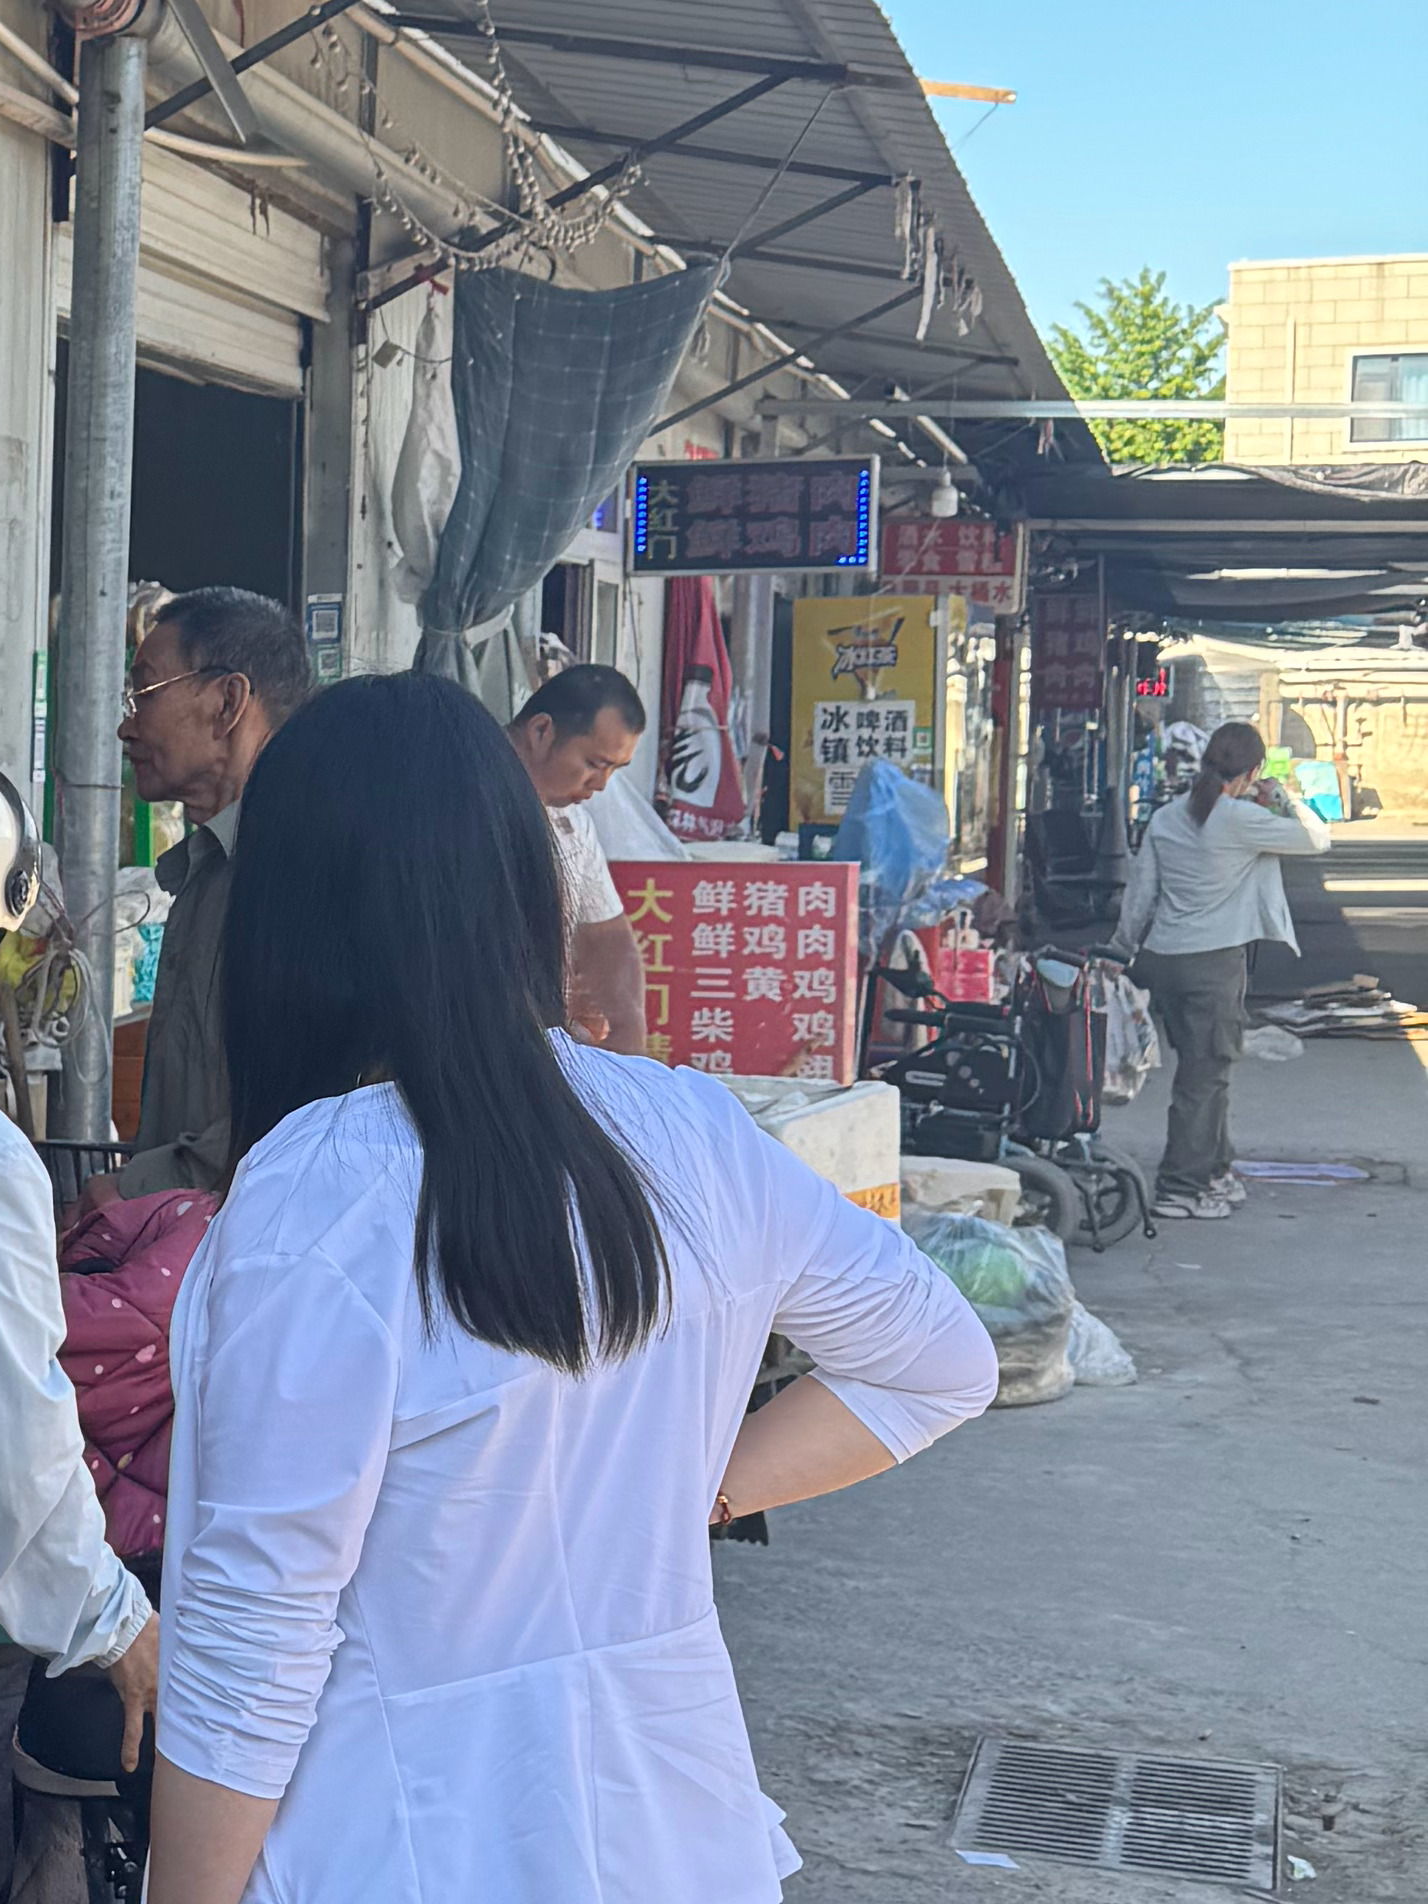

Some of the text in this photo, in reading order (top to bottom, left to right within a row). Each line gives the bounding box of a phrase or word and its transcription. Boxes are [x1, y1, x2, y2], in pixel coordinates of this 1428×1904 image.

[692, 881, 836, 918] 鲜猪肉
[691, 923, 835, 960] 鲜鸡肉
[690, 967, 836, 1004] 三黄鸡
